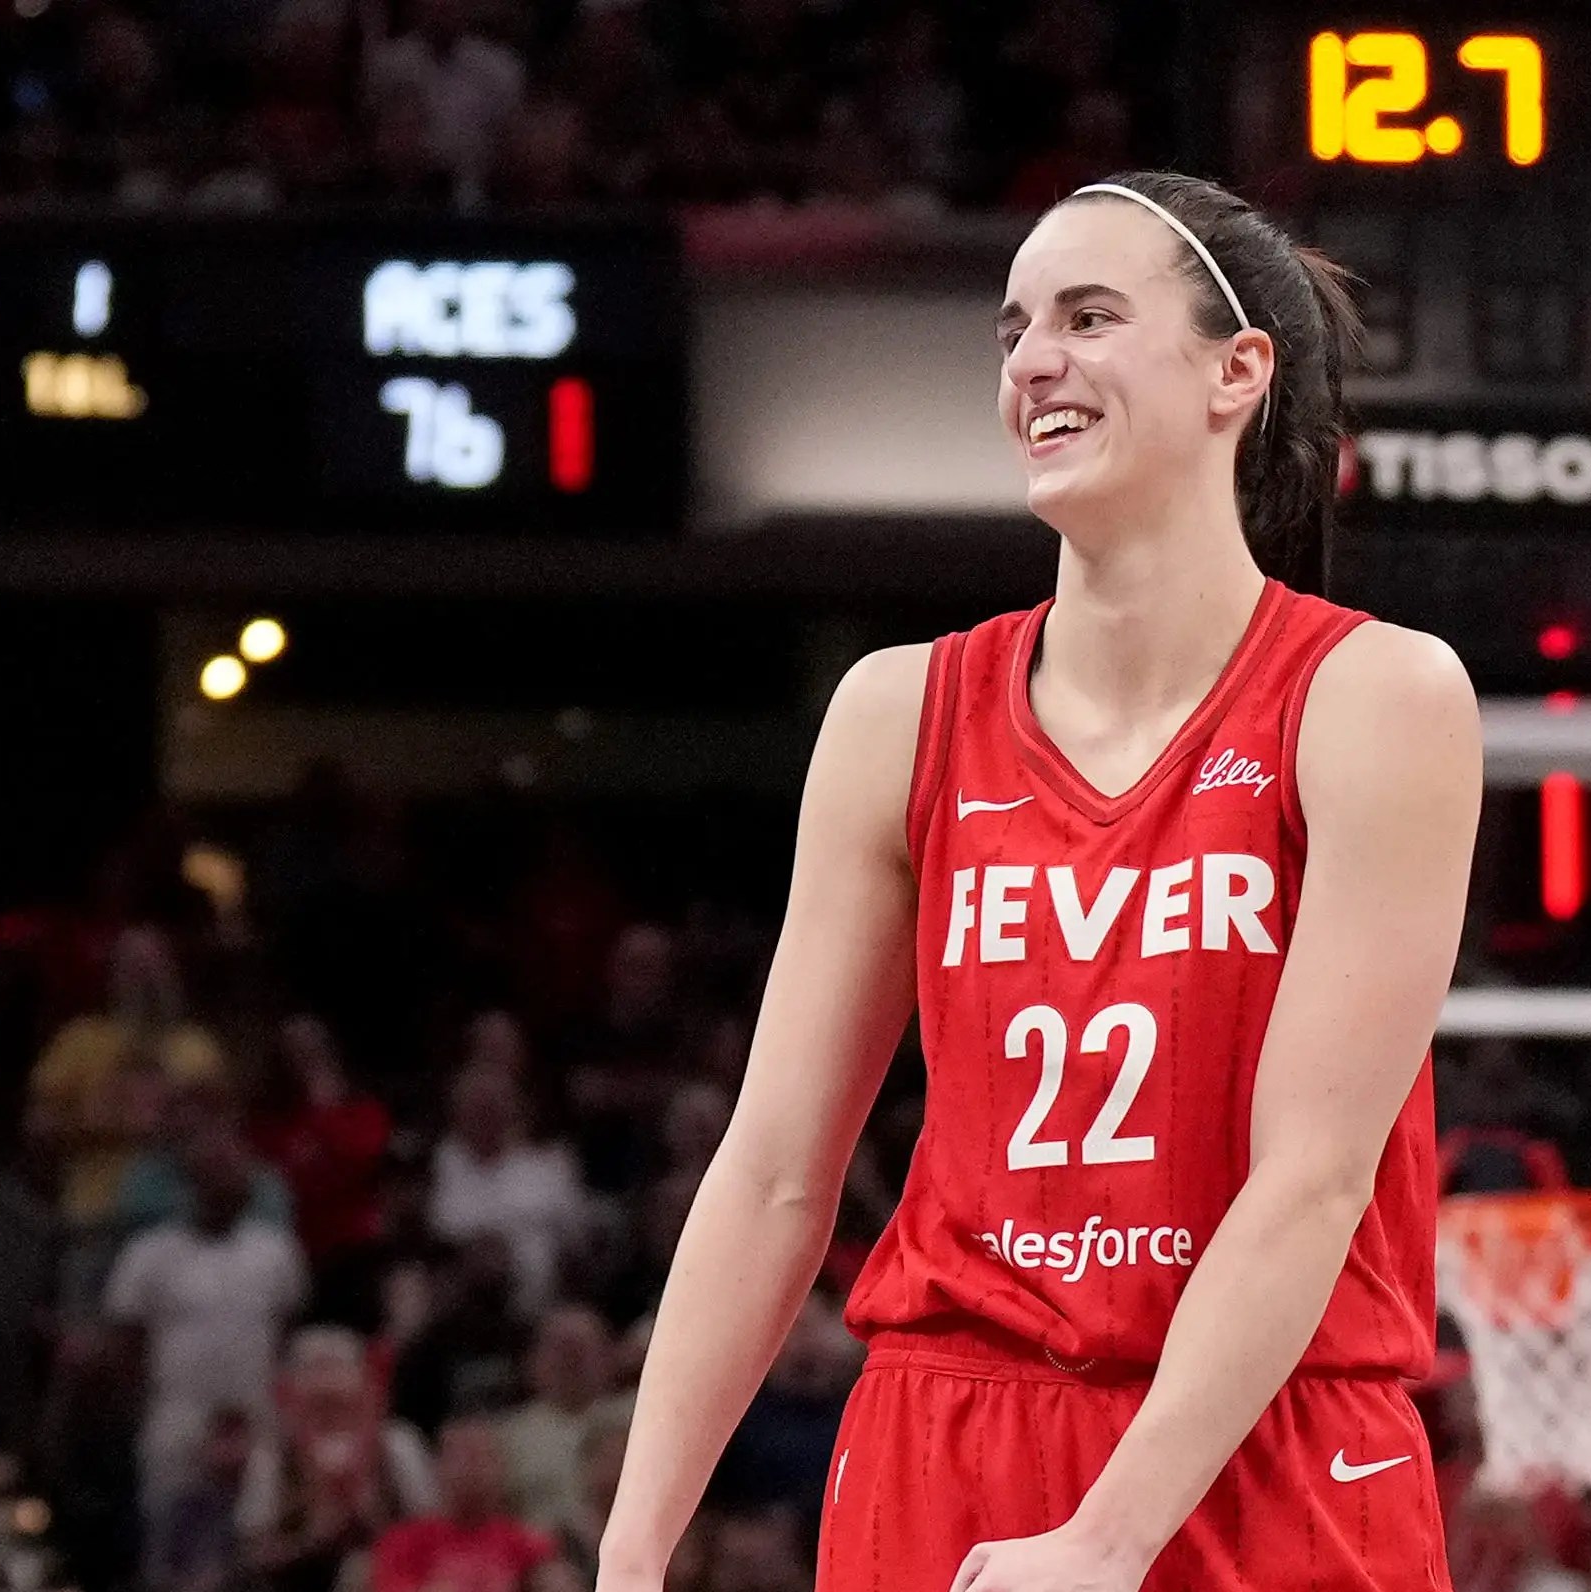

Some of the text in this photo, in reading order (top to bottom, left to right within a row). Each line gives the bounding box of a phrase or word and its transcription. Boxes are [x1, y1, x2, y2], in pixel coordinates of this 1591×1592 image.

[1310, 32, 1543, 165] 12.7
[363, 260, 577, 358] ACES
[380, 377, 505, 488] 76
[1192, 748, 1275, 798] Lilly
[941, 852, 1279, 968] FEVER
[1004, 1003, 1158, 1171] 22
[970, 1215, 1192, 1283] alesforce
